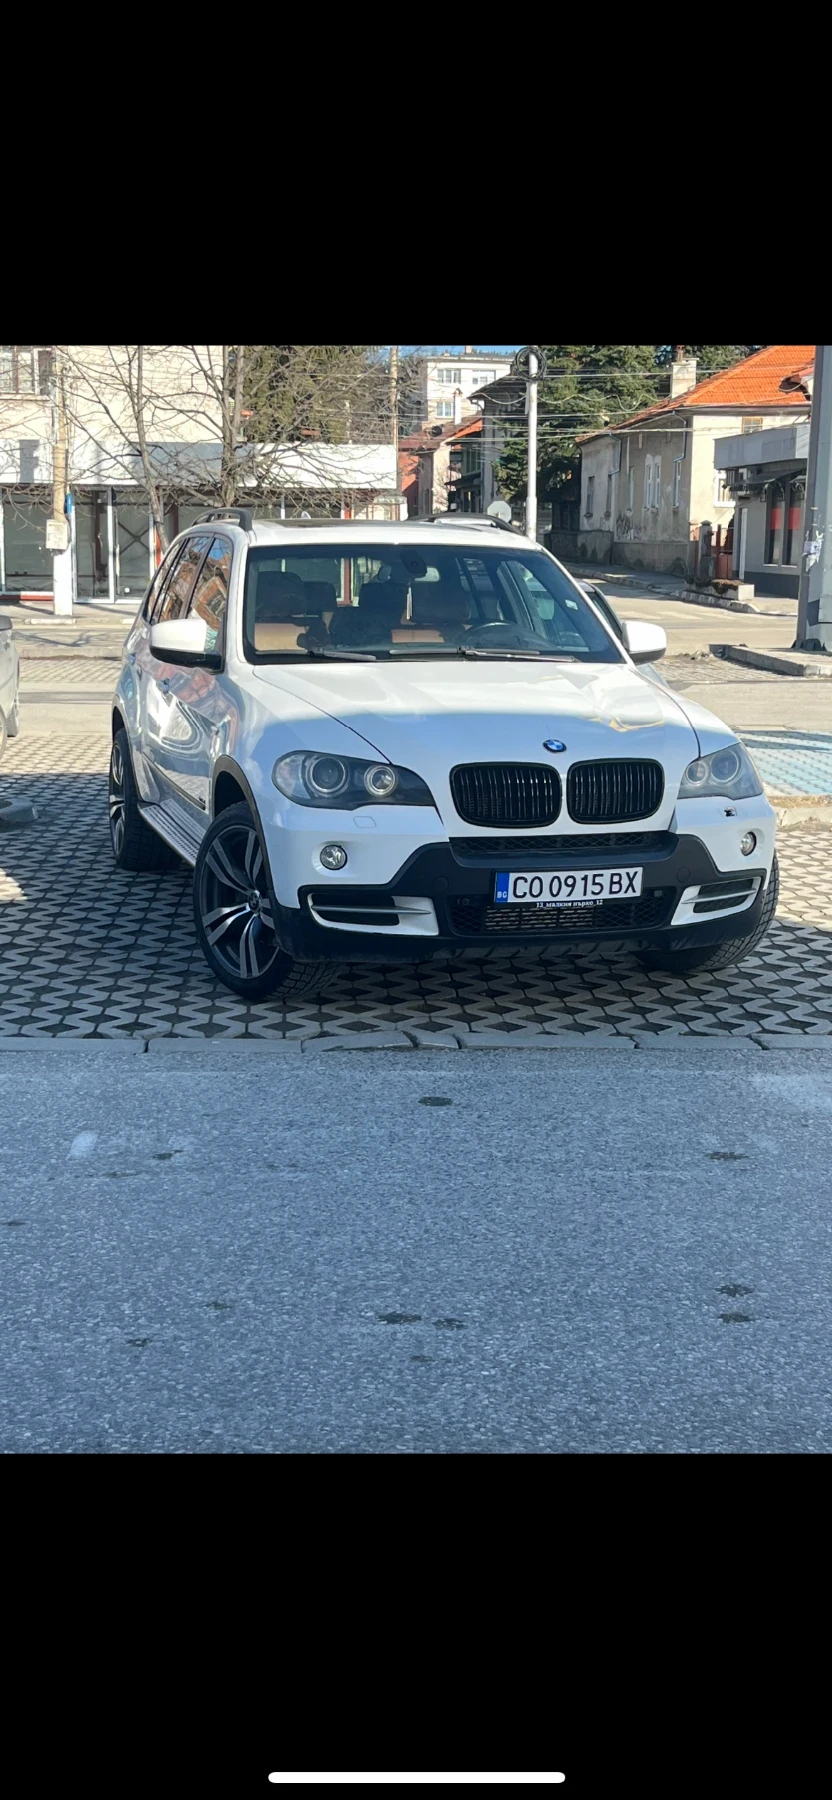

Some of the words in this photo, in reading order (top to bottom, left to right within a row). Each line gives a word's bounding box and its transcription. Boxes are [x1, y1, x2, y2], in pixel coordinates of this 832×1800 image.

[513, 876, 543, 898] CO
[549, 873, 604, 898] 0915
[609, 871, 638, 895] BX
[497, 891, 508, 899] BG
